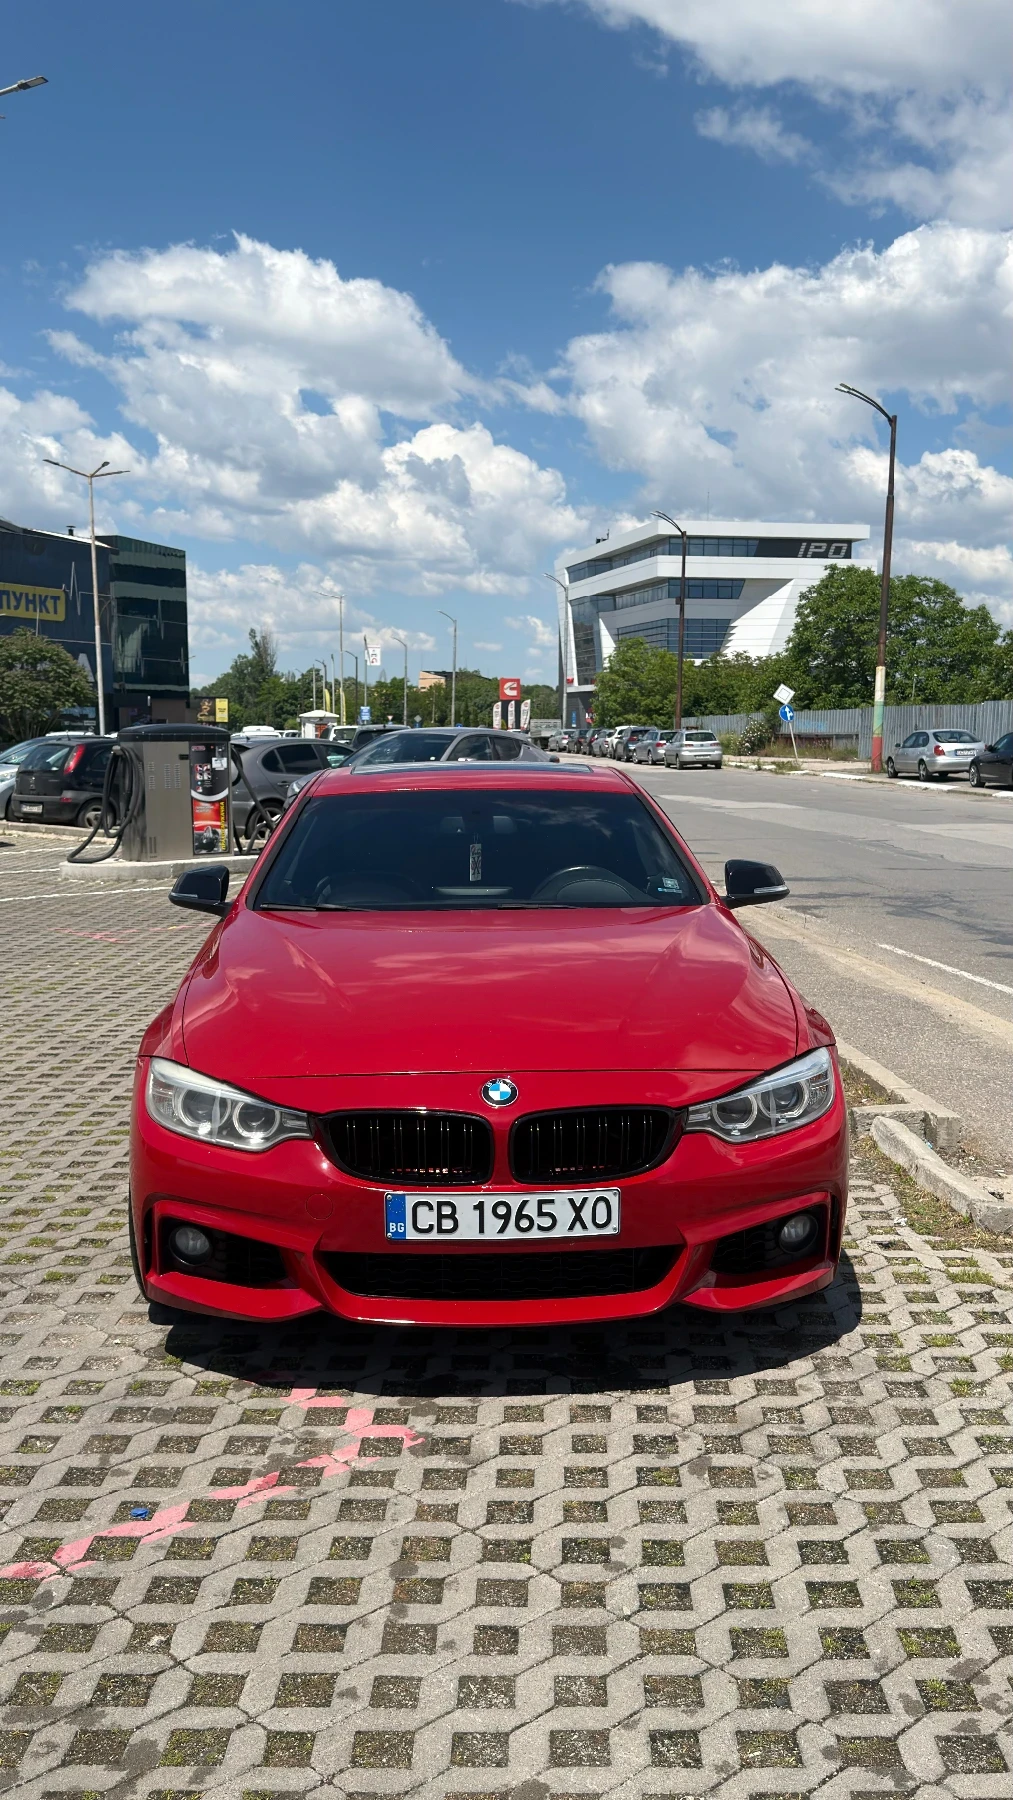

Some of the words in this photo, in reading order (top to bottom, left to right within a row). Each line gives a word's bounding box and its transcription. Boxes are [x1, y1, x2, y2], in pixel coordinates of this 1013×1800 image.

[797, 542, 848, 558] IPO
[0, 590, 60, 615] ПУНКТ
[411, 1200, 459, 1234] CB
[472, 1198, 558, 1234] 1965
[389, 1222, 405, 1233] BG
